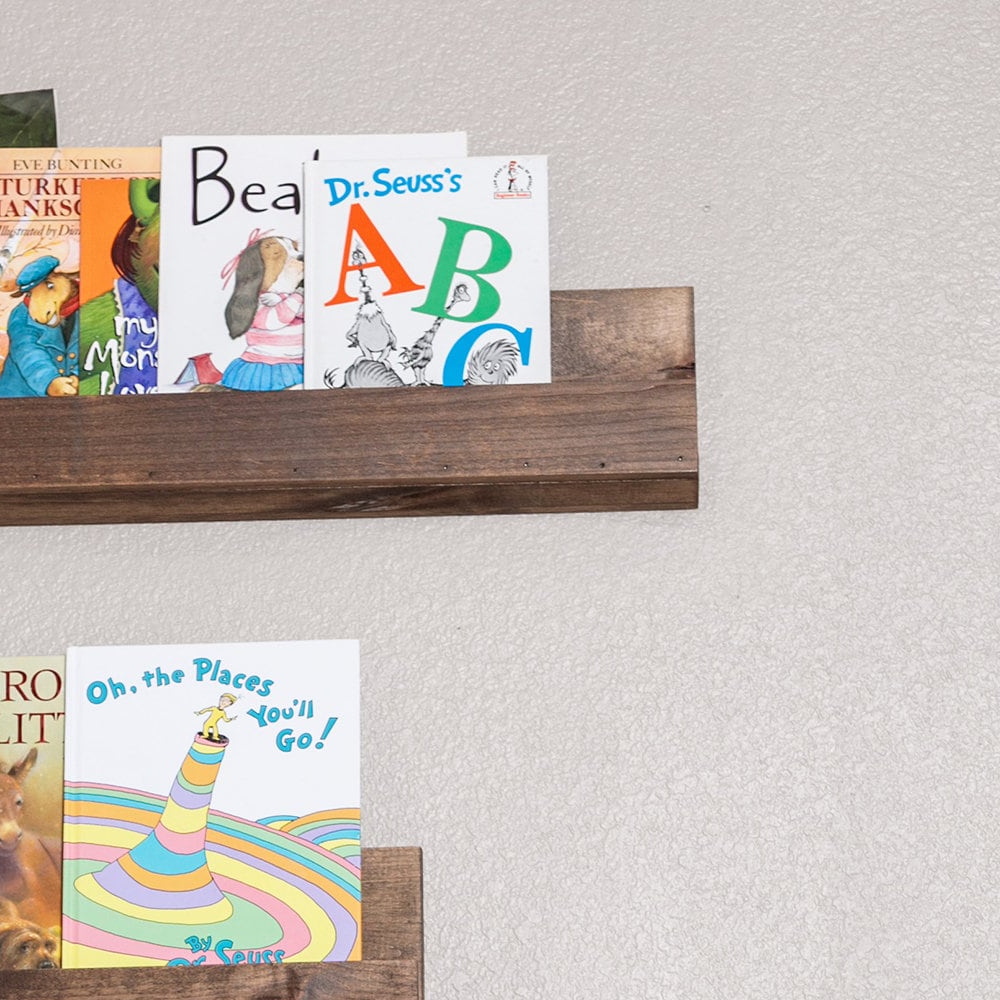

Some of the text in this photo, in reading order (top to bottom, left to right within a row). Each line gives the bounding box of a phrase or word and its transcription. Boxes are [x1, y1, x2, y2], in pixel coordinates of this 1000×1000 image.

[13, 158, 123, 171] EVE BUNTING
[192, 146, 319, 225] Bea
[324, 177, 370, 207] Dr.
[373, 168, 463, 197] Seuss's
[114, 316, 158, 349] my
[0, 669, 63, 702] RO
[86, 657, 275, 705] Oh, the Places
[246, 699, 315, 729] You'll
[276, 717, 339, 754] Go!
[184, 935, 212, 954] By
